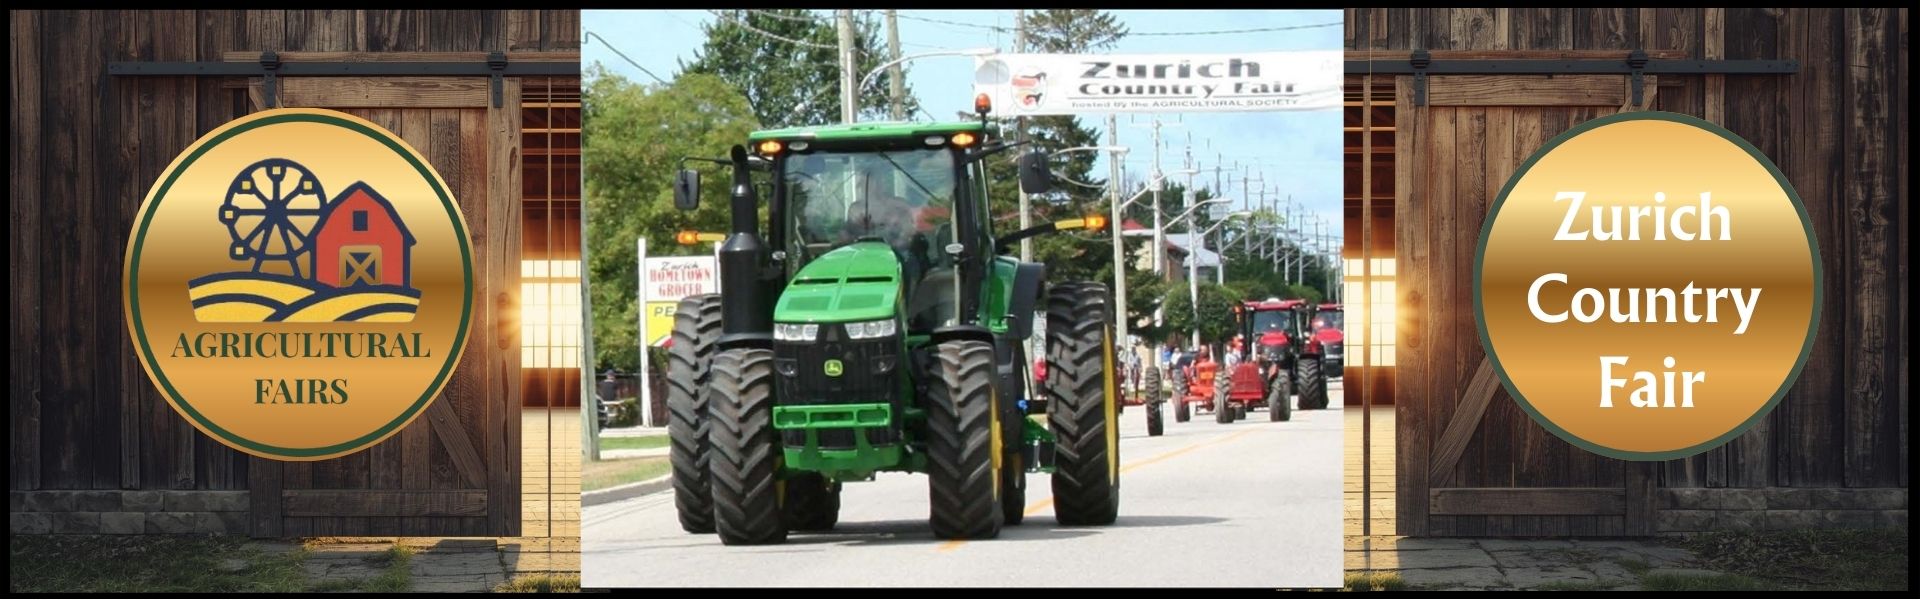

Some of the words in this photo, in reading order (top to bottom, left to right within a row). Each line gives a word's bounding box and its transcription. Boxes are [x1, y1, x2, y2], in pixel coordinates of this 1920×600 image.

[1080, 58, 1261, 80] Zurich
[1079, 82, 1219, 98] Country
[1233, 81, 1297, 95] Fair
[1072, 100, 1111, 108] hosted
[1113, 101, 1127, 110] by
[1131, 100, 1150, 108] the
[1152, 99, 1243, 108] AGRICULTURAL
[1245, 98, 1299, 107] SOCIETY
[649, 267, 711, 282] HOMETOWN
[659, 283, 702, 297] GROCER
